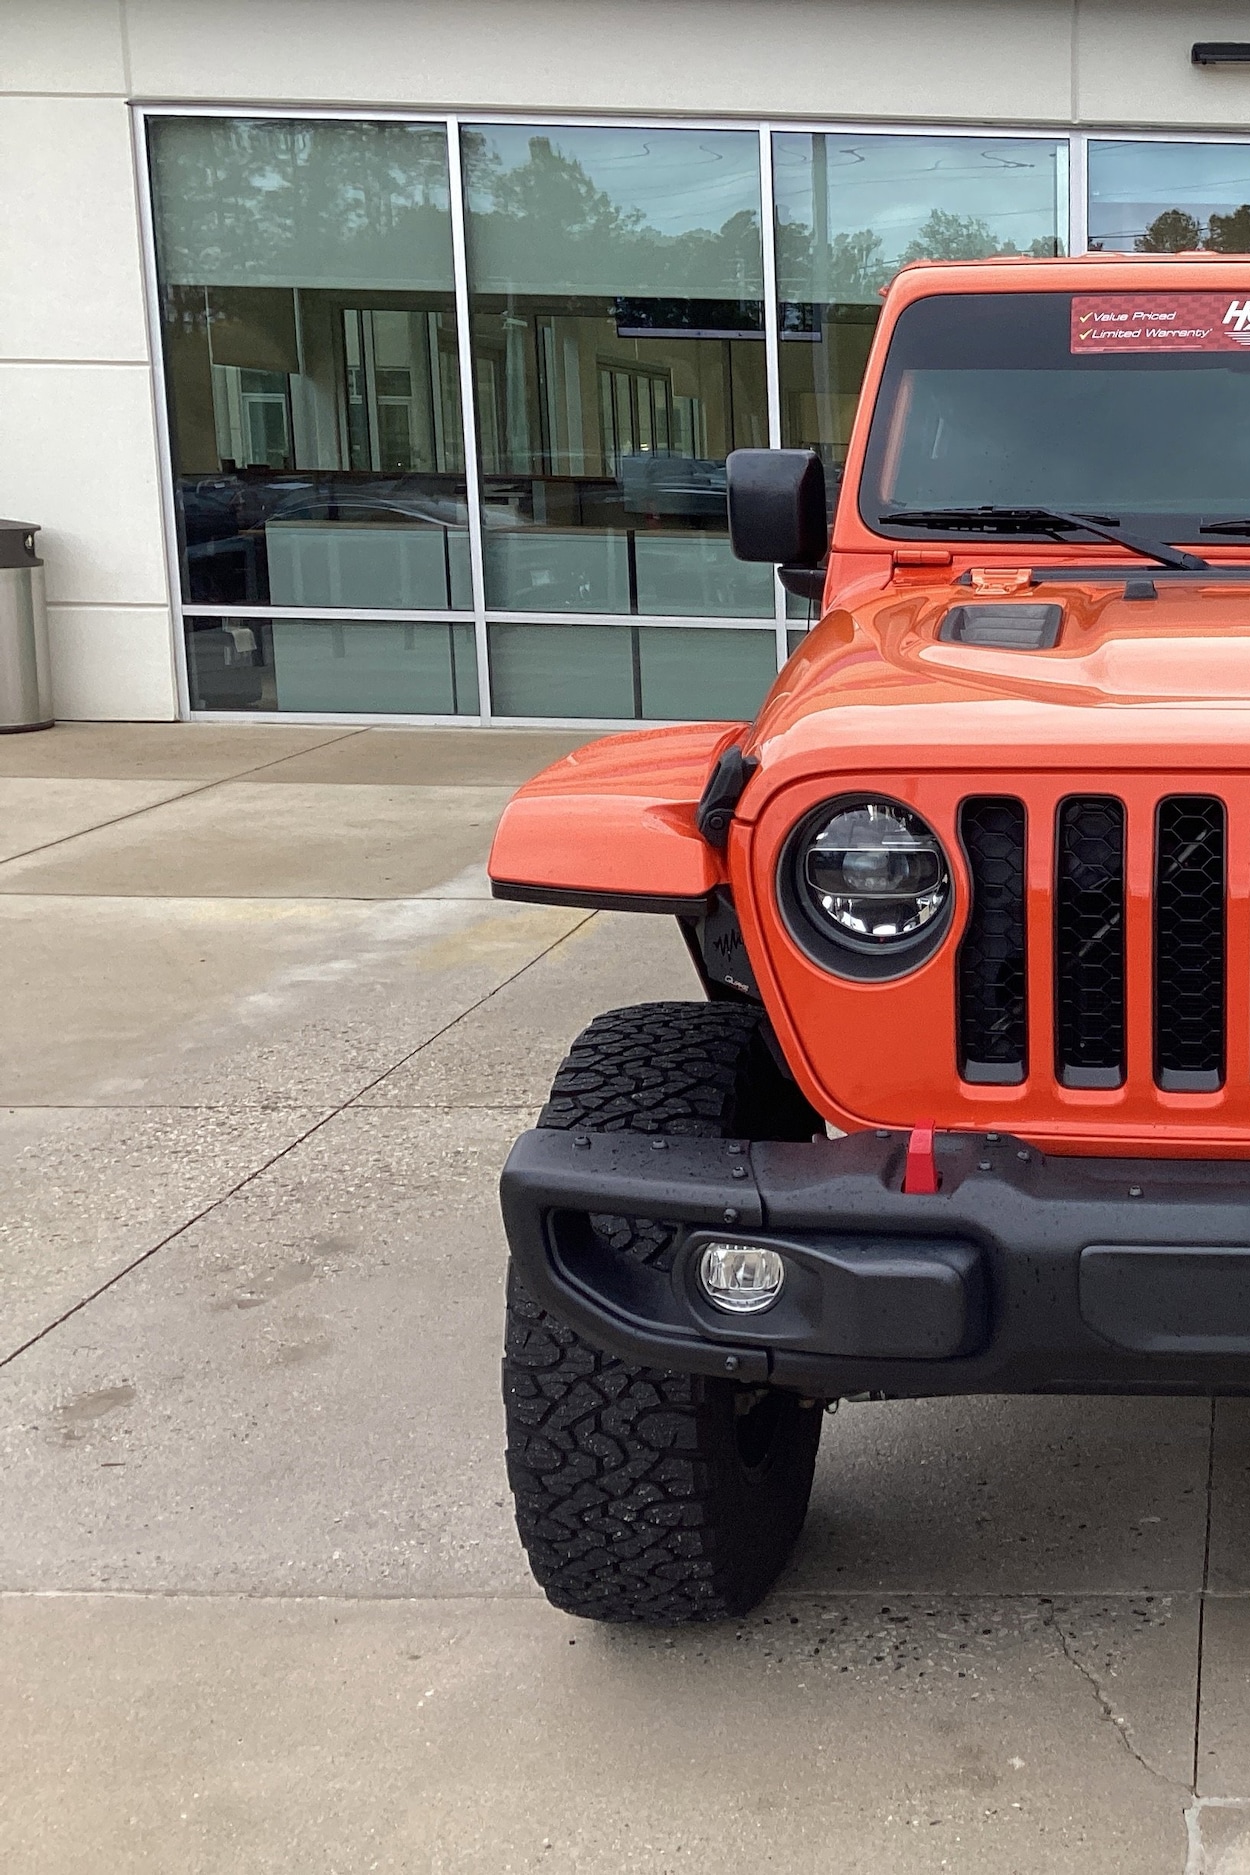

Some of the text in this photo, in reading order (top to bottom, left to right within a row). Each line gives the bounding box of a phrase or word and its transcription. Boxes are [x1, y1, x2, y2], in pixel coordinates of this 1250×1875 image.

[1093, 312, 1176, 322] Value Priced
[1092, 329, 1141, 339] Limited
